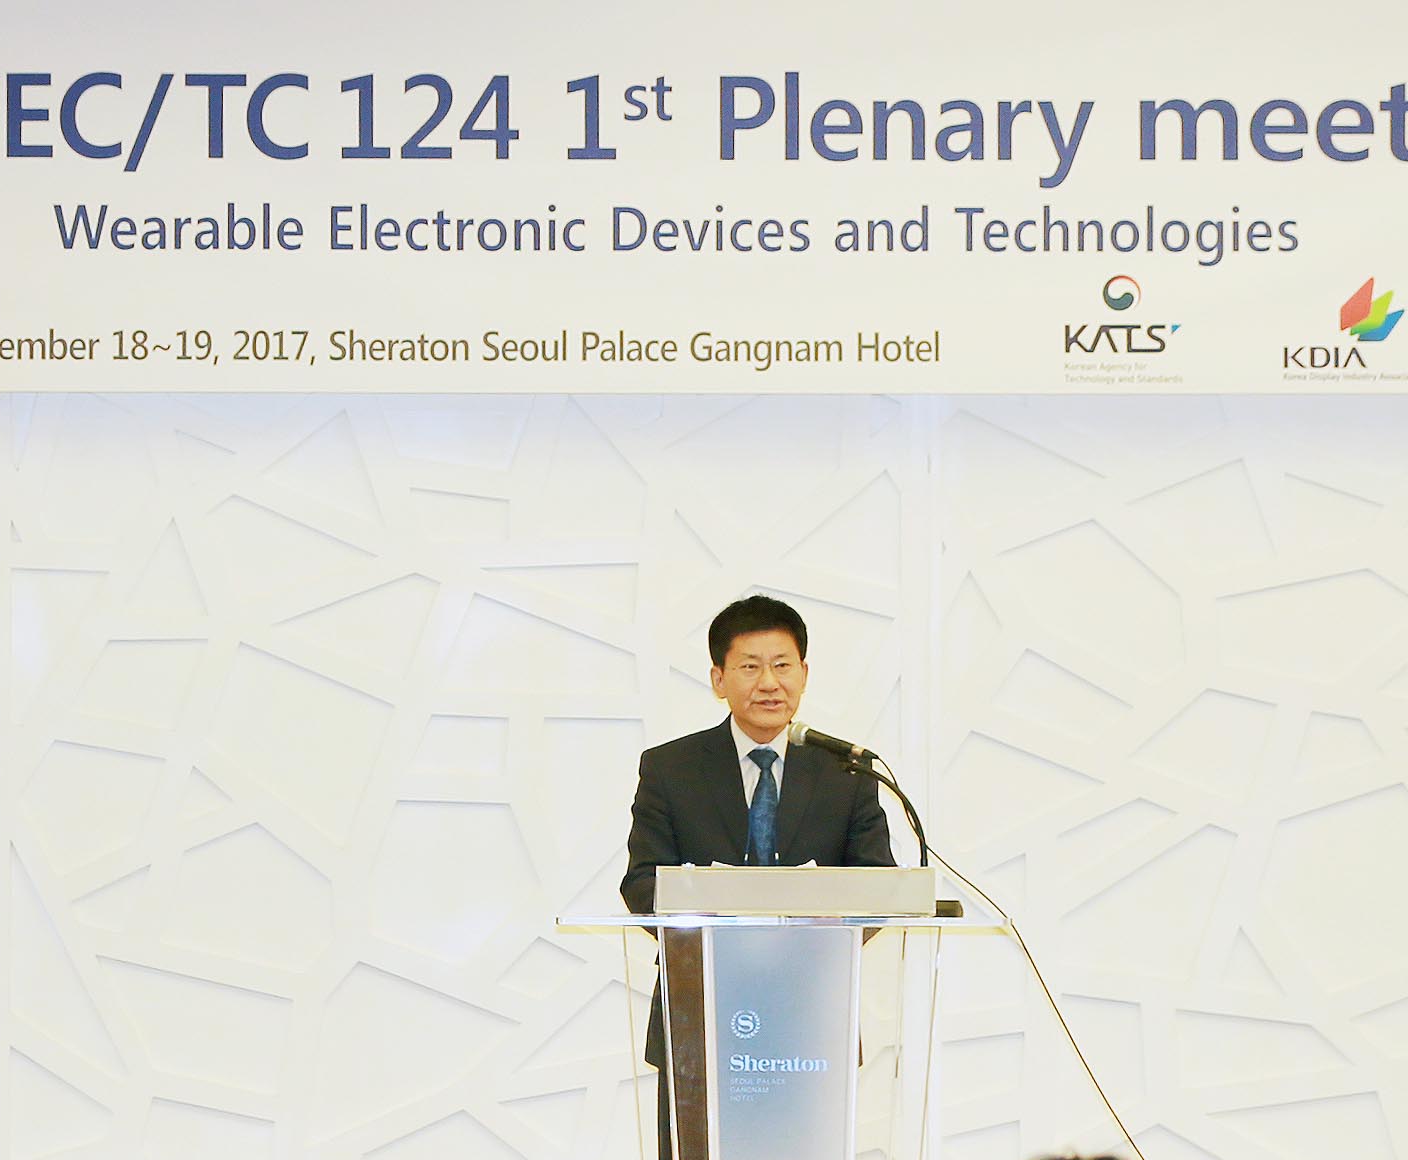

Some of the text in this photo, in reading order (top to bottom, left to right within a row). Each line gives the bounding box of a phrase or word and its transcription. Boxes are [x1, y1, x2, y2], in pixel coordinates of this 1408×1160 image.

[341, 73, 519, 160] 124
[567, 72, 672, 161] 1st
[720, 72, 1095, 188] Plenary
[54, 202, 1299, 266] Wearable Electronic Devices and Technologies
[113, 330, 219, 366] 18~19,
[233, 330, 316, 367] 2017,
[329, 329, 469, 362] Sheraton
[482, 329, 566, 362] Seoul
[582, 329, 677, 363] Palace
[690, 331, 843, 372] Gangnam
[857, 330, 940, 363] Hotel
[1064, 323, 1166, 354] KATS
[1283, 346, 1368, 369] KDIA
[730, 1054, 827, 1072] Sheraton
